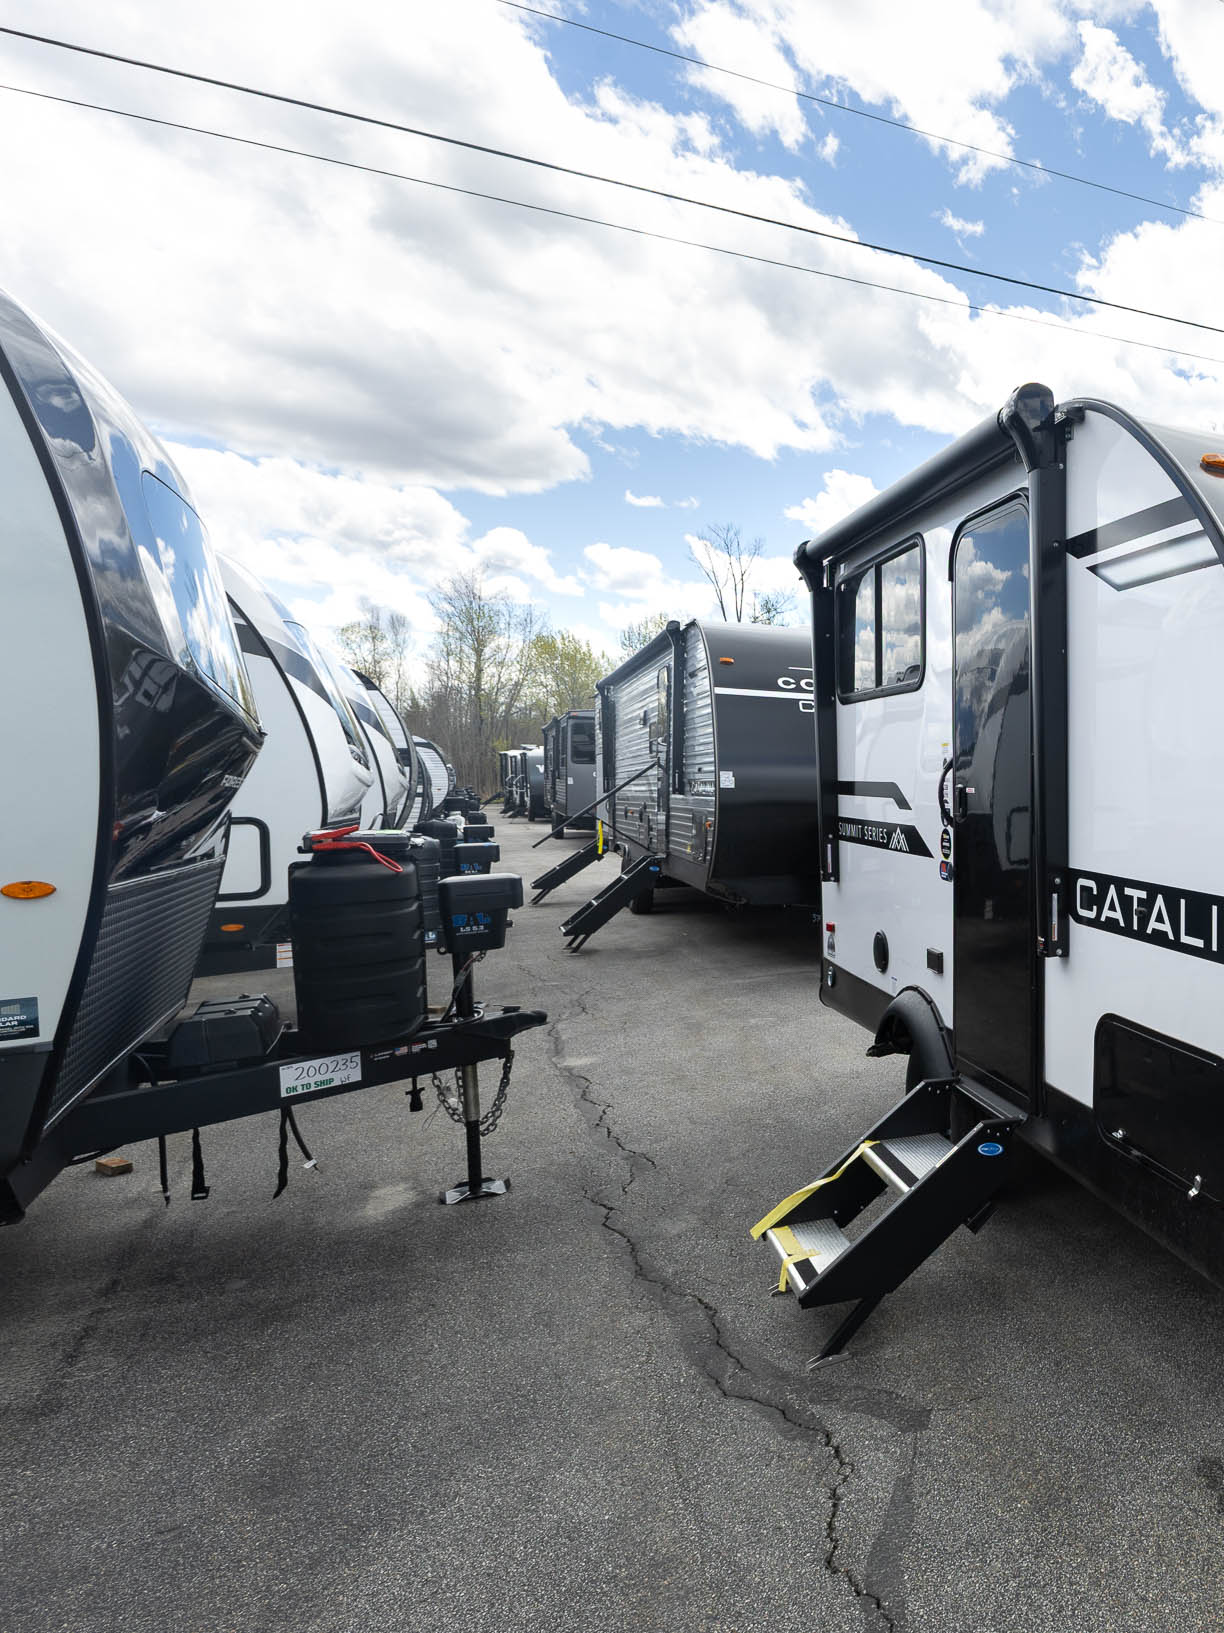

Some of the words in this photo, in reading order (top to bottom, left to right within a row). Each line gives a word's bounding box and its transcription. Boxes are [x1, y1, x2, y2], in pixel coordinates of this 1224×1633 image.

[839, 822, 862, 838] SUMMIT
[864, 826, 888, 843] SERIES
[294, 1055, 360, 1081] 200235
[286, 1086, 298, 1095] OK
[301, 1082, 311, 1091] TO
[314, 1077, 334, 1088] SHIP
